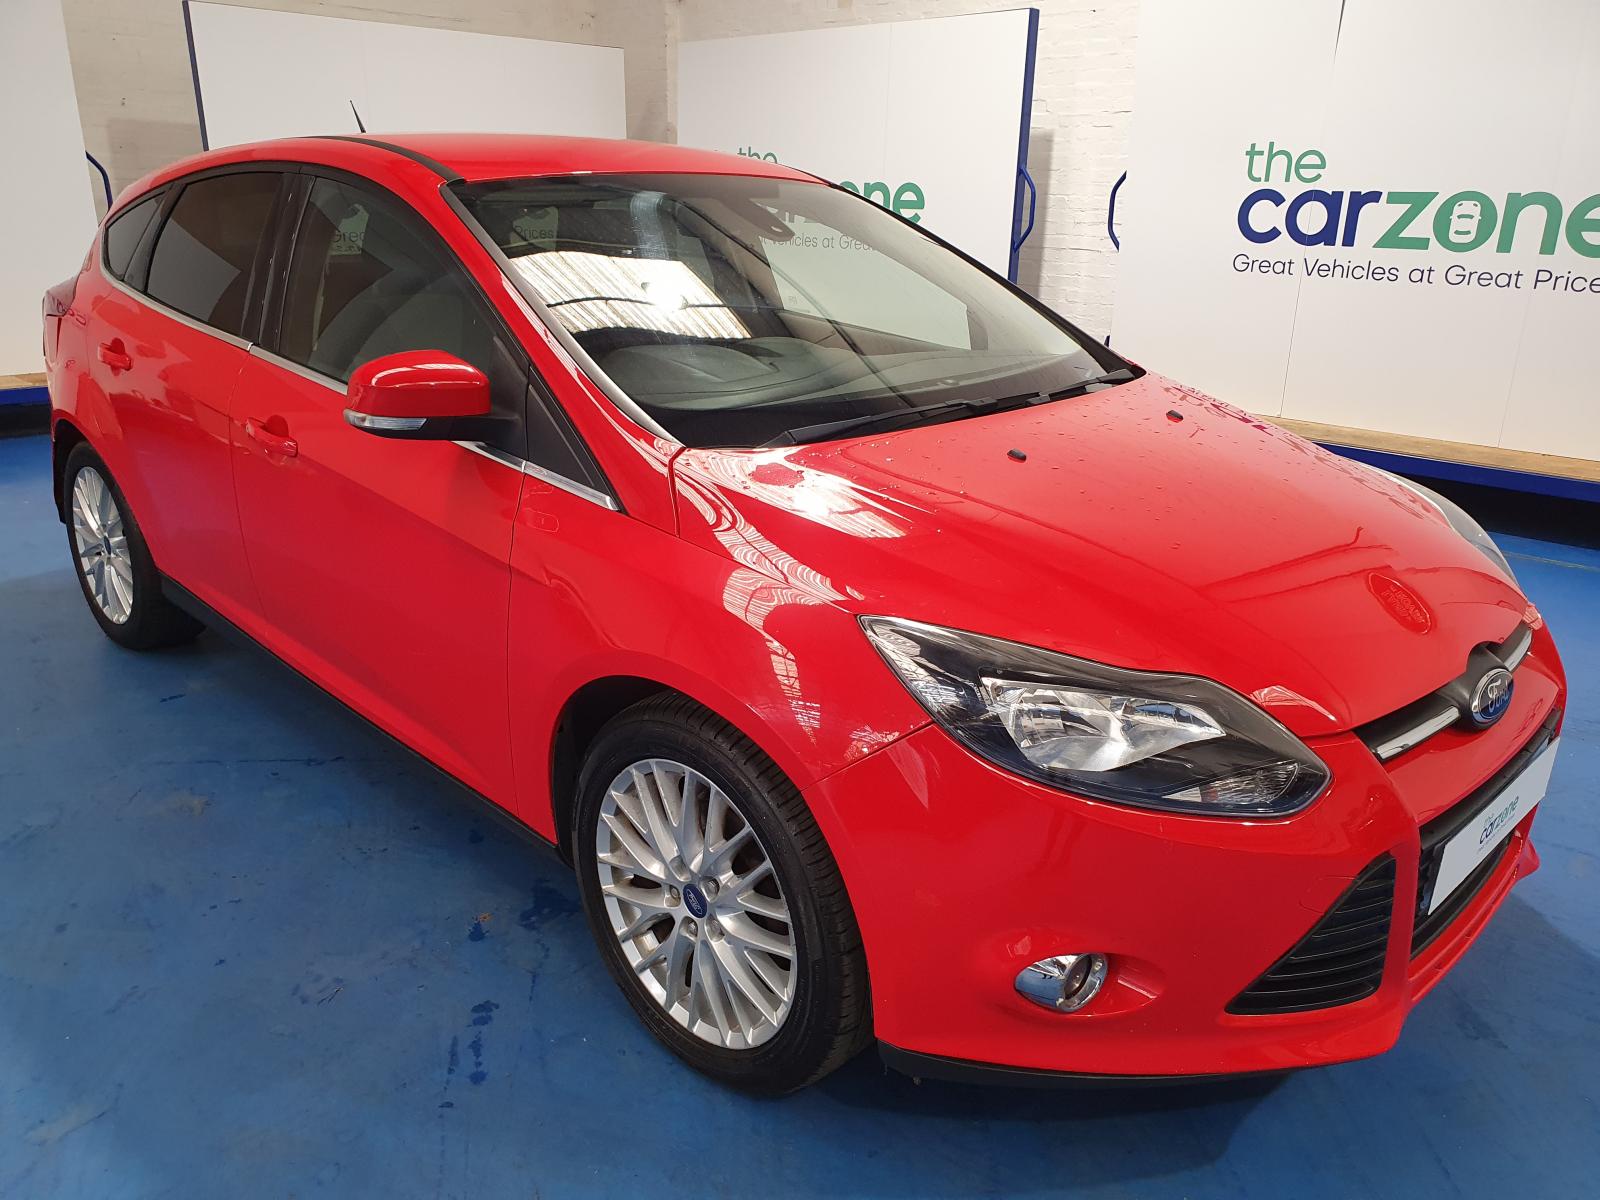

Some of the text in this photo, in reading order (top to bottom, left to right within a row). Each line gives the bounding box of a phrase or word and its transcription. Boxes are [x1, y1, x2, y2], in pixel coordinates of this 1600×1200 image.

[1245, 141, 1327, 184] the
[1237, 188, 1600, 259] carzone
[821, 236, 834, 249] at
[1232, 253, 1295, 276] Great
[1303, 257, 1399, 283] Vehicles
[1408, 265, 1435, 285] at
[1444, 264, 1524, 290] Great
[1487, 678, 1509, 713] Ford
